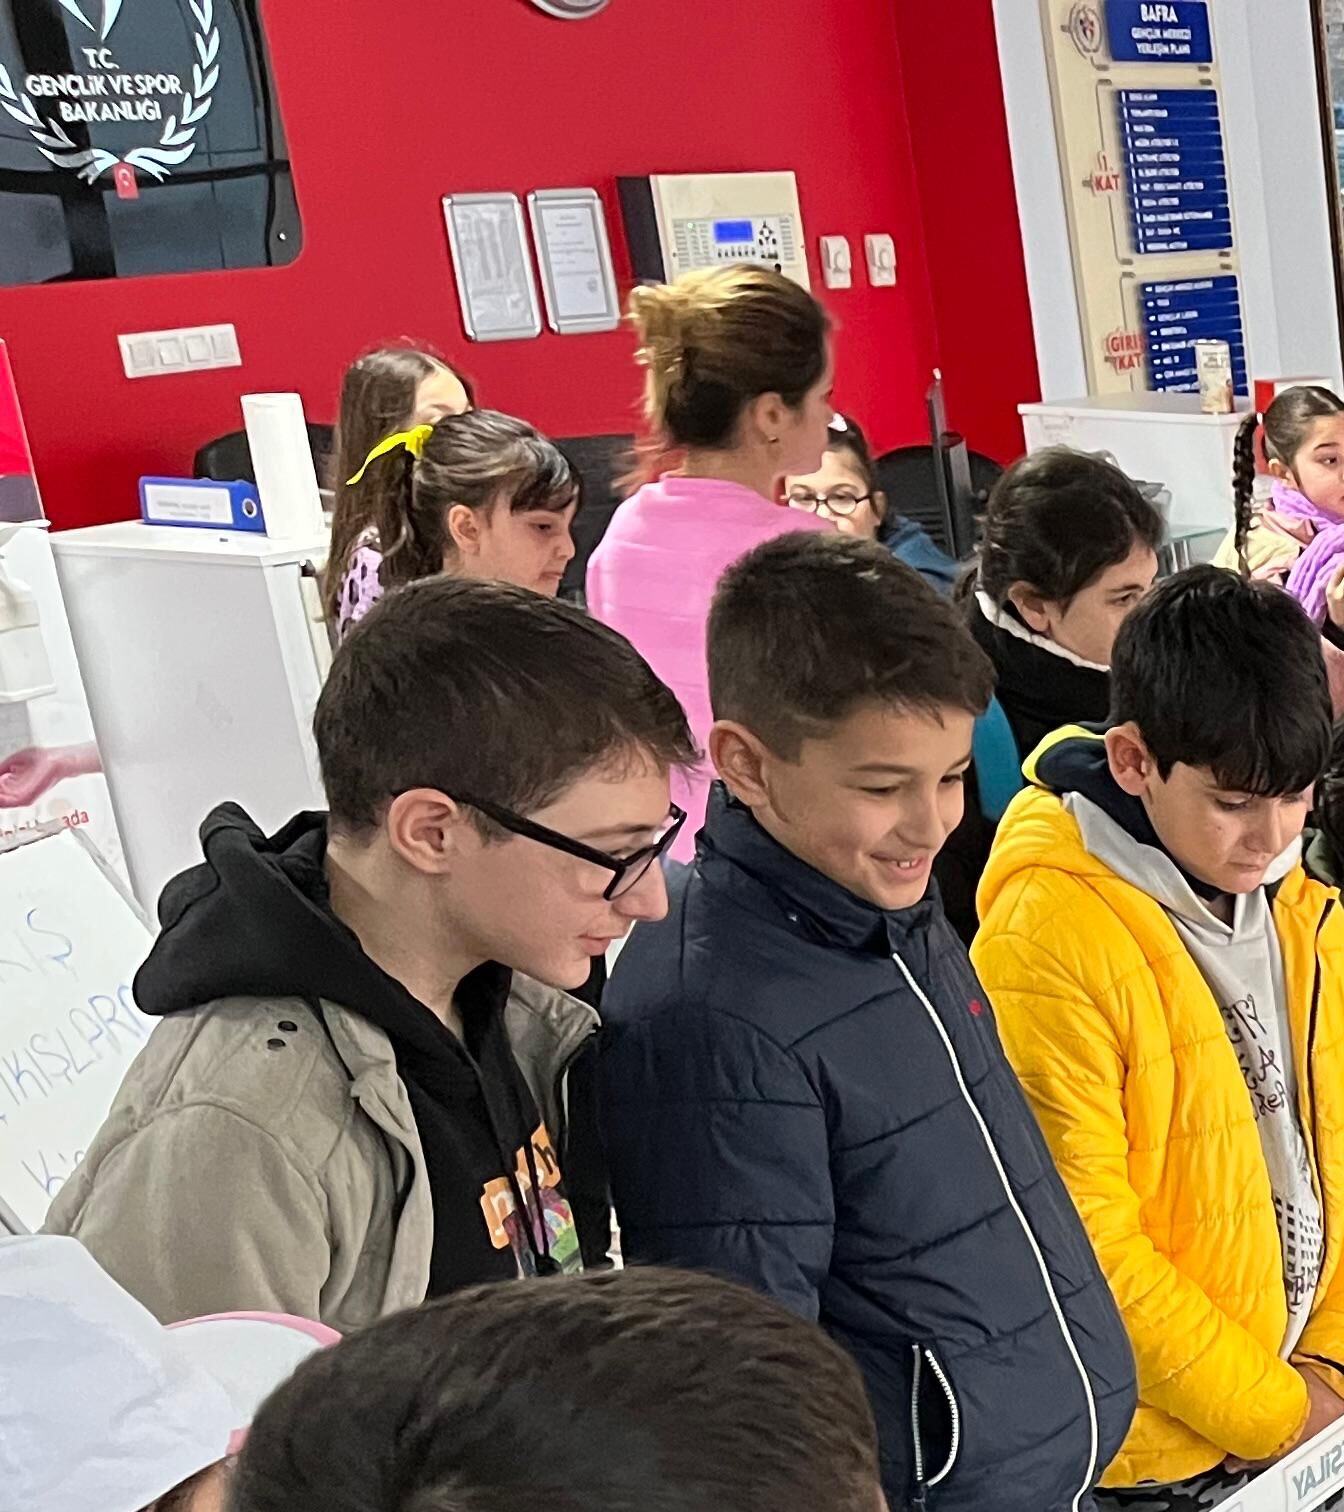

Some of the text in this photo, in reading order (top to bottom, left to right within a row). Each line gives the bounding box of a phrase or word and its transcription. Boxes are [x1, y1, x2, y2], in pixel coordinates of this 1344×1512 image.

[1140, 3, 1178, 22] BAFRA
[107, 74, 133, 95] VE
[135, 74, 182, 95] SPOR
[59, 98, 162, 122] BAKANLIĞI
[1094, 175, 1120, 191] KAT
